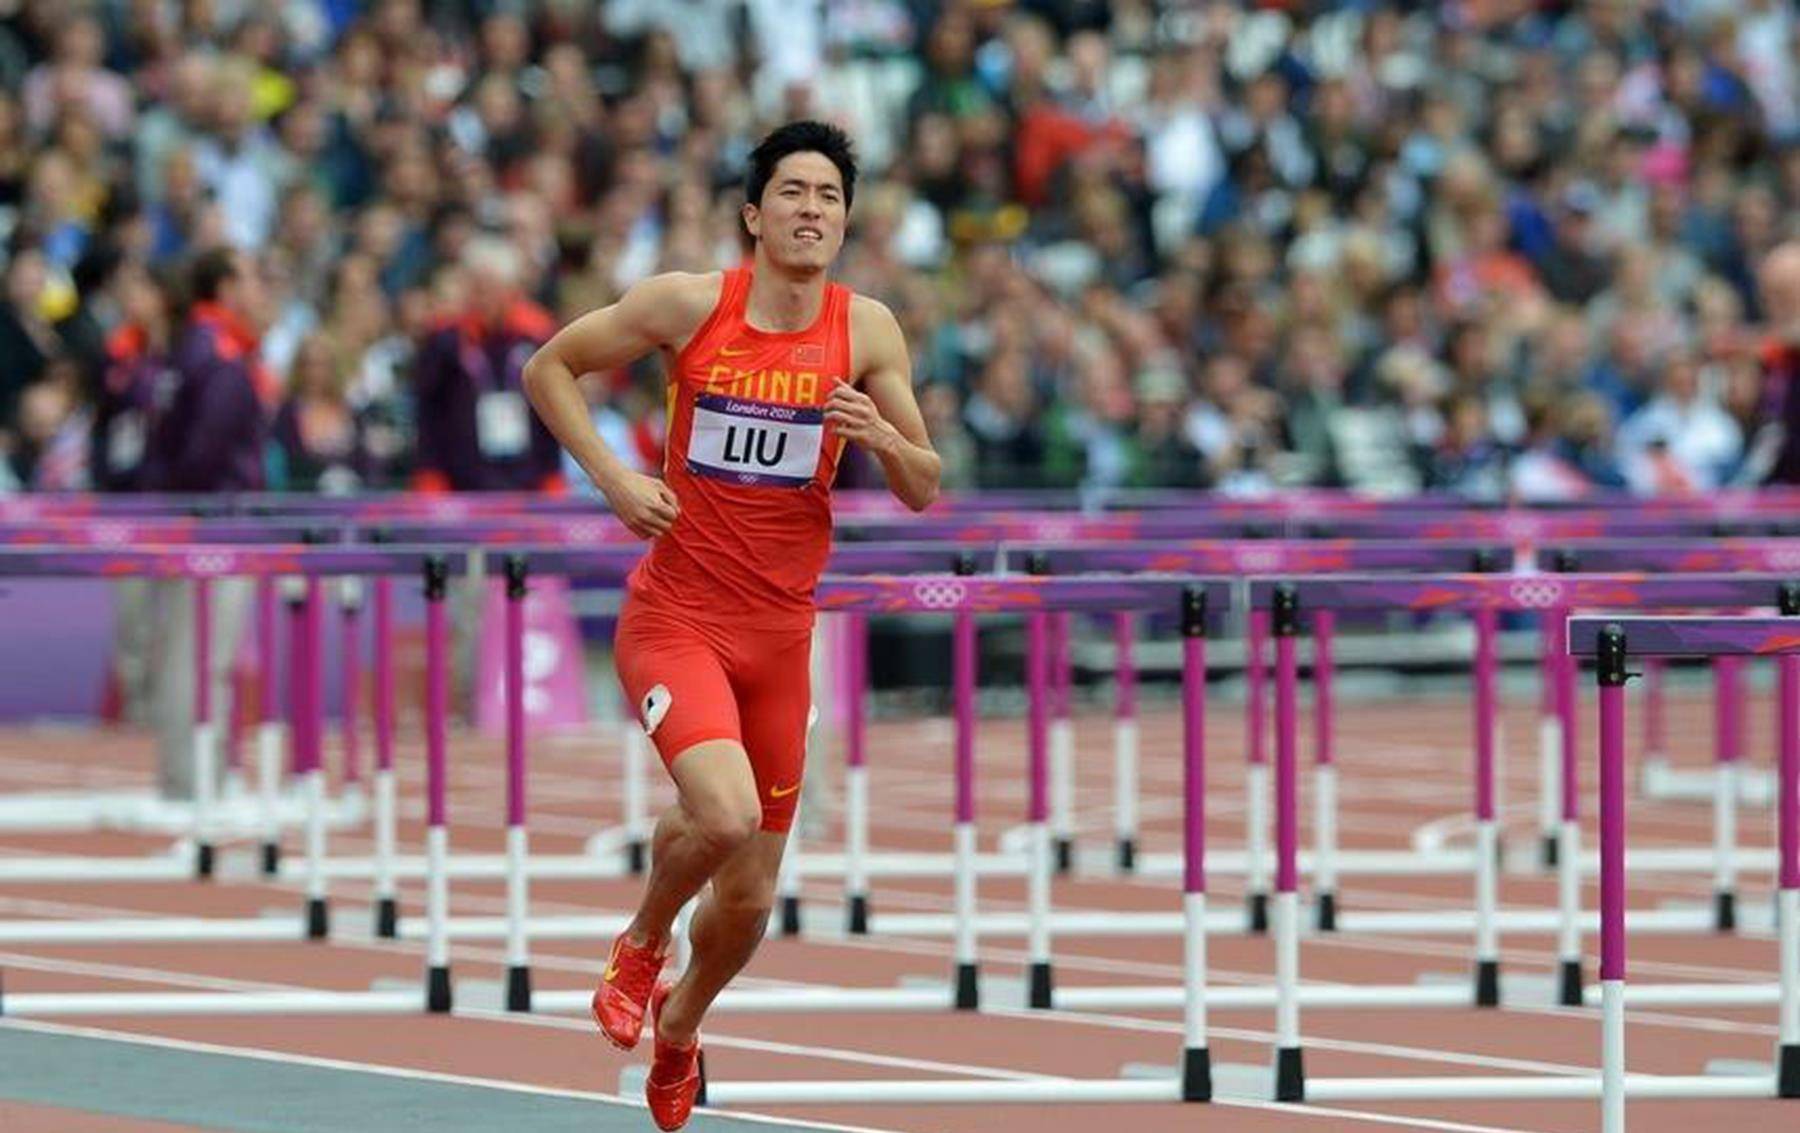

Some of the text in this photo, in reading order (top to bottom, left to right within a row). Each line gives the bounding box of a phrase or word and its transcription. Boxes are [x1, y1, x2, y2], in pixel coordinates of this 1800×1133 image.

[705, 364, 818, 405] CHINA
[725, 400, 797, 420] London 2012
[723, 425, 788, 467] LIU
